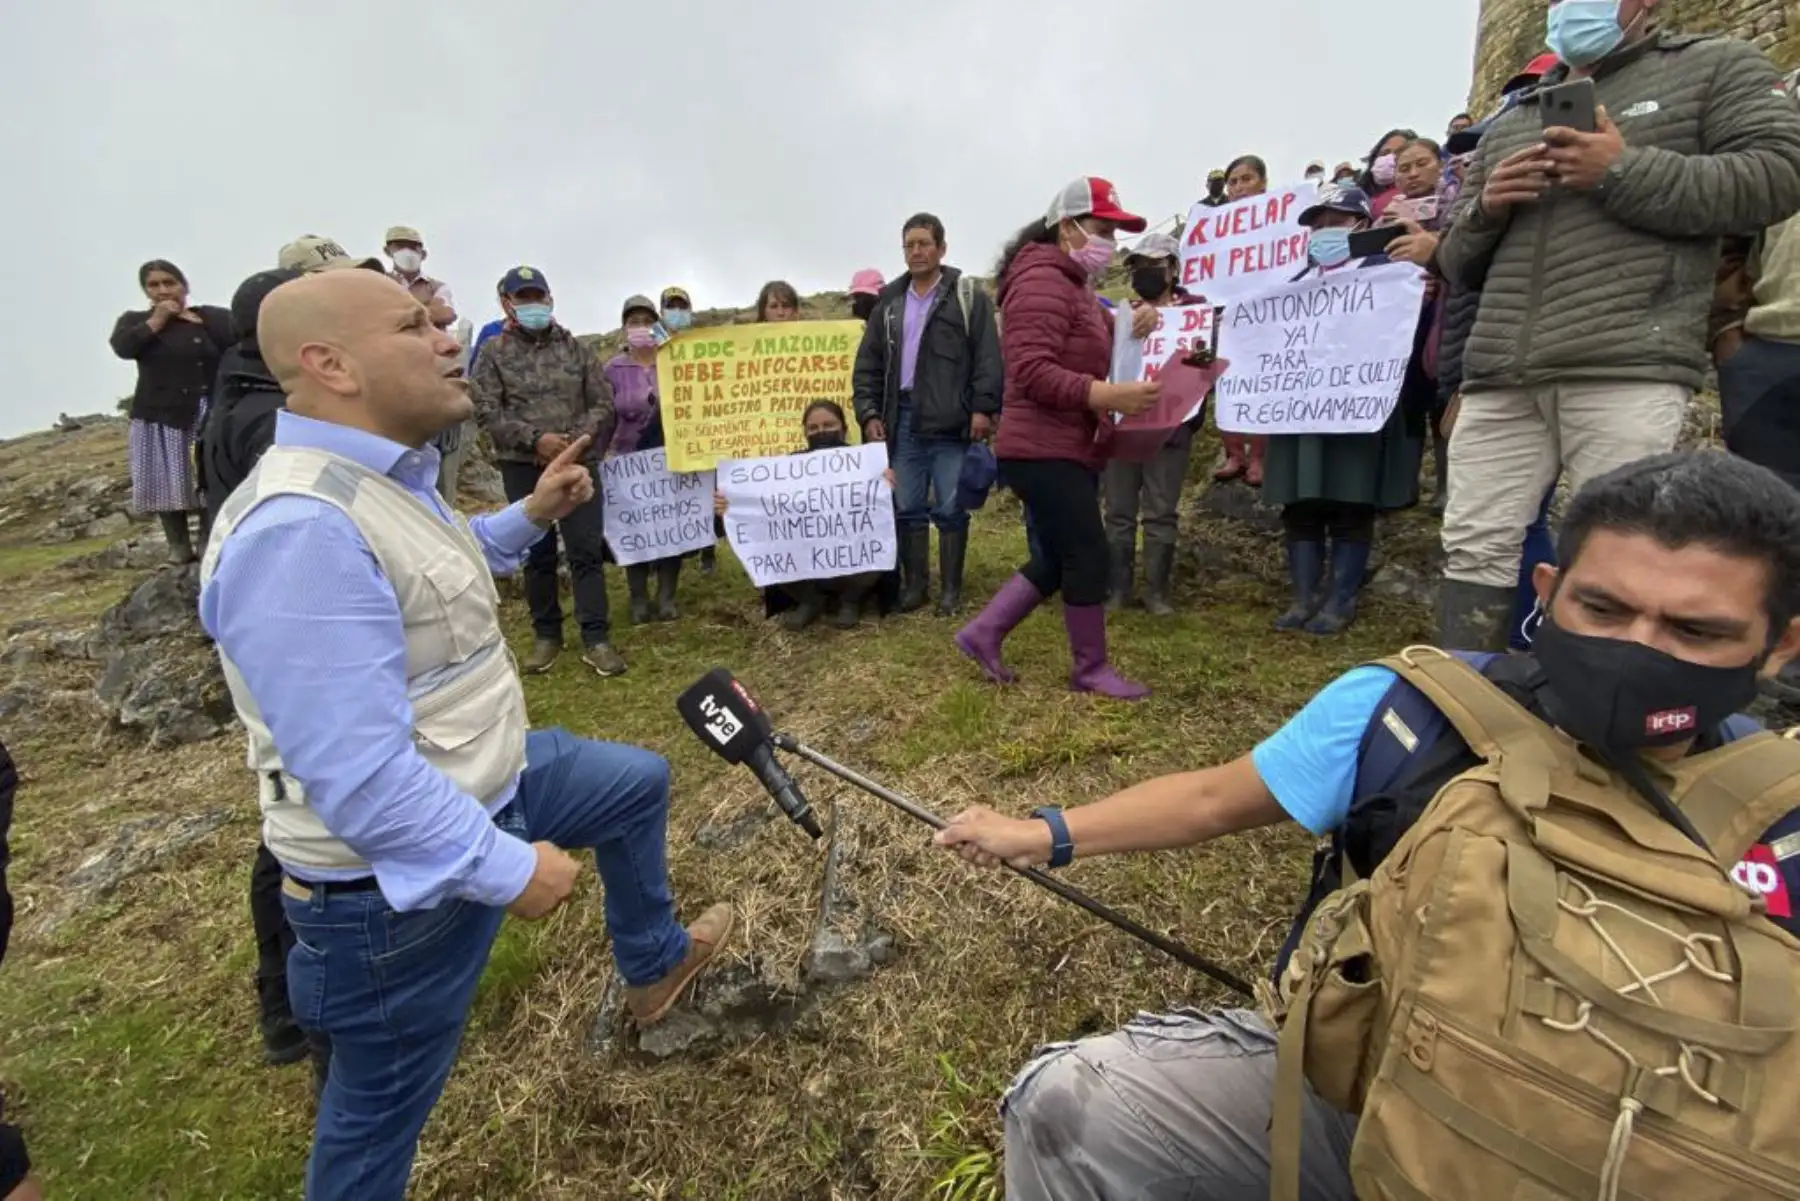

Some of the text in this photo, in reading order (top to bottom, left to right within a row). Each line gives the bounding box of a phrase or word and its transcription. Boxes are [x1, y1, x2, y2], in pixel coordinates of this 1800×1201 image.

[1187, 192, 1297, 247] KUELAP
[1182, 254, 1216, 286] EN
[1179, 308, 1213, 333] DE
[669, 341, 685, 361] LA
[692, 340, 735, 359] DDC
[751, 334, 850, 356] AMAZONAS
[1283, 321, 1320, 349] YA!
[672, 354, 850, 383] DEBE ENFOCARSE
[1258, 349, 1309, 372] PARA
[1329, 364, 1355, 388] DE
[673, 385, 693, 403] EN
[703, 383, 724, 401] LA
[674, 404, 693, 420] DE
[702, 399, 762, 418] NUESTRO
[758, 418, 767, 431] A
[687, 441, 704, 455] EL
[730, 450, 862, 484] SOLUCIÓN
[605, 470, 703, 507] E CULTURA
[618, 496, 702, 526] QUEREMOS
[736, 522, 749, 545] E
[747, 540, 884, 574] PARA KUELAP
[699, 694, 736, 737] tvpe
